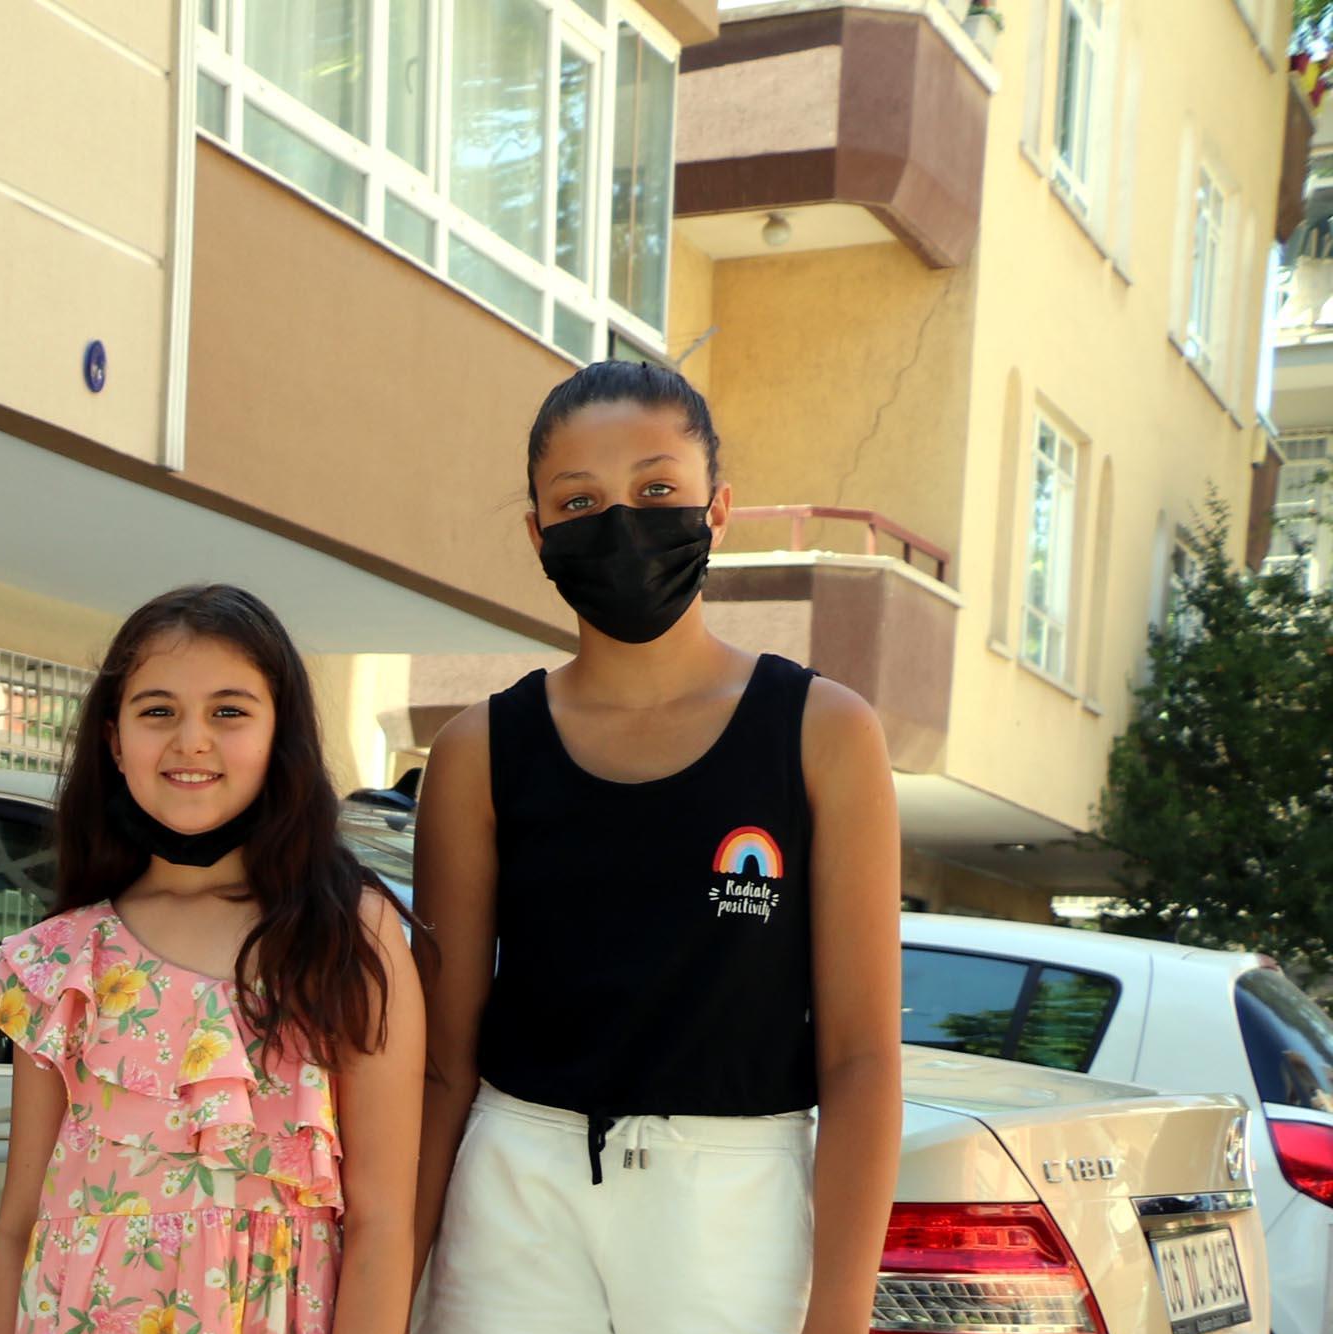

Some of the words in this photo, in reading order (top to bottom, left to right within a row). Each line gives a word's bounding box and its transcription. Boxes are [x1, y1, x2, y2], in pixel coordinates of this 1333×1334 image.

[726, 880, 771, 899] Radiate
[717, 898, 771, 923] positivity
[1162, 1248, 1185, 1313] 06
